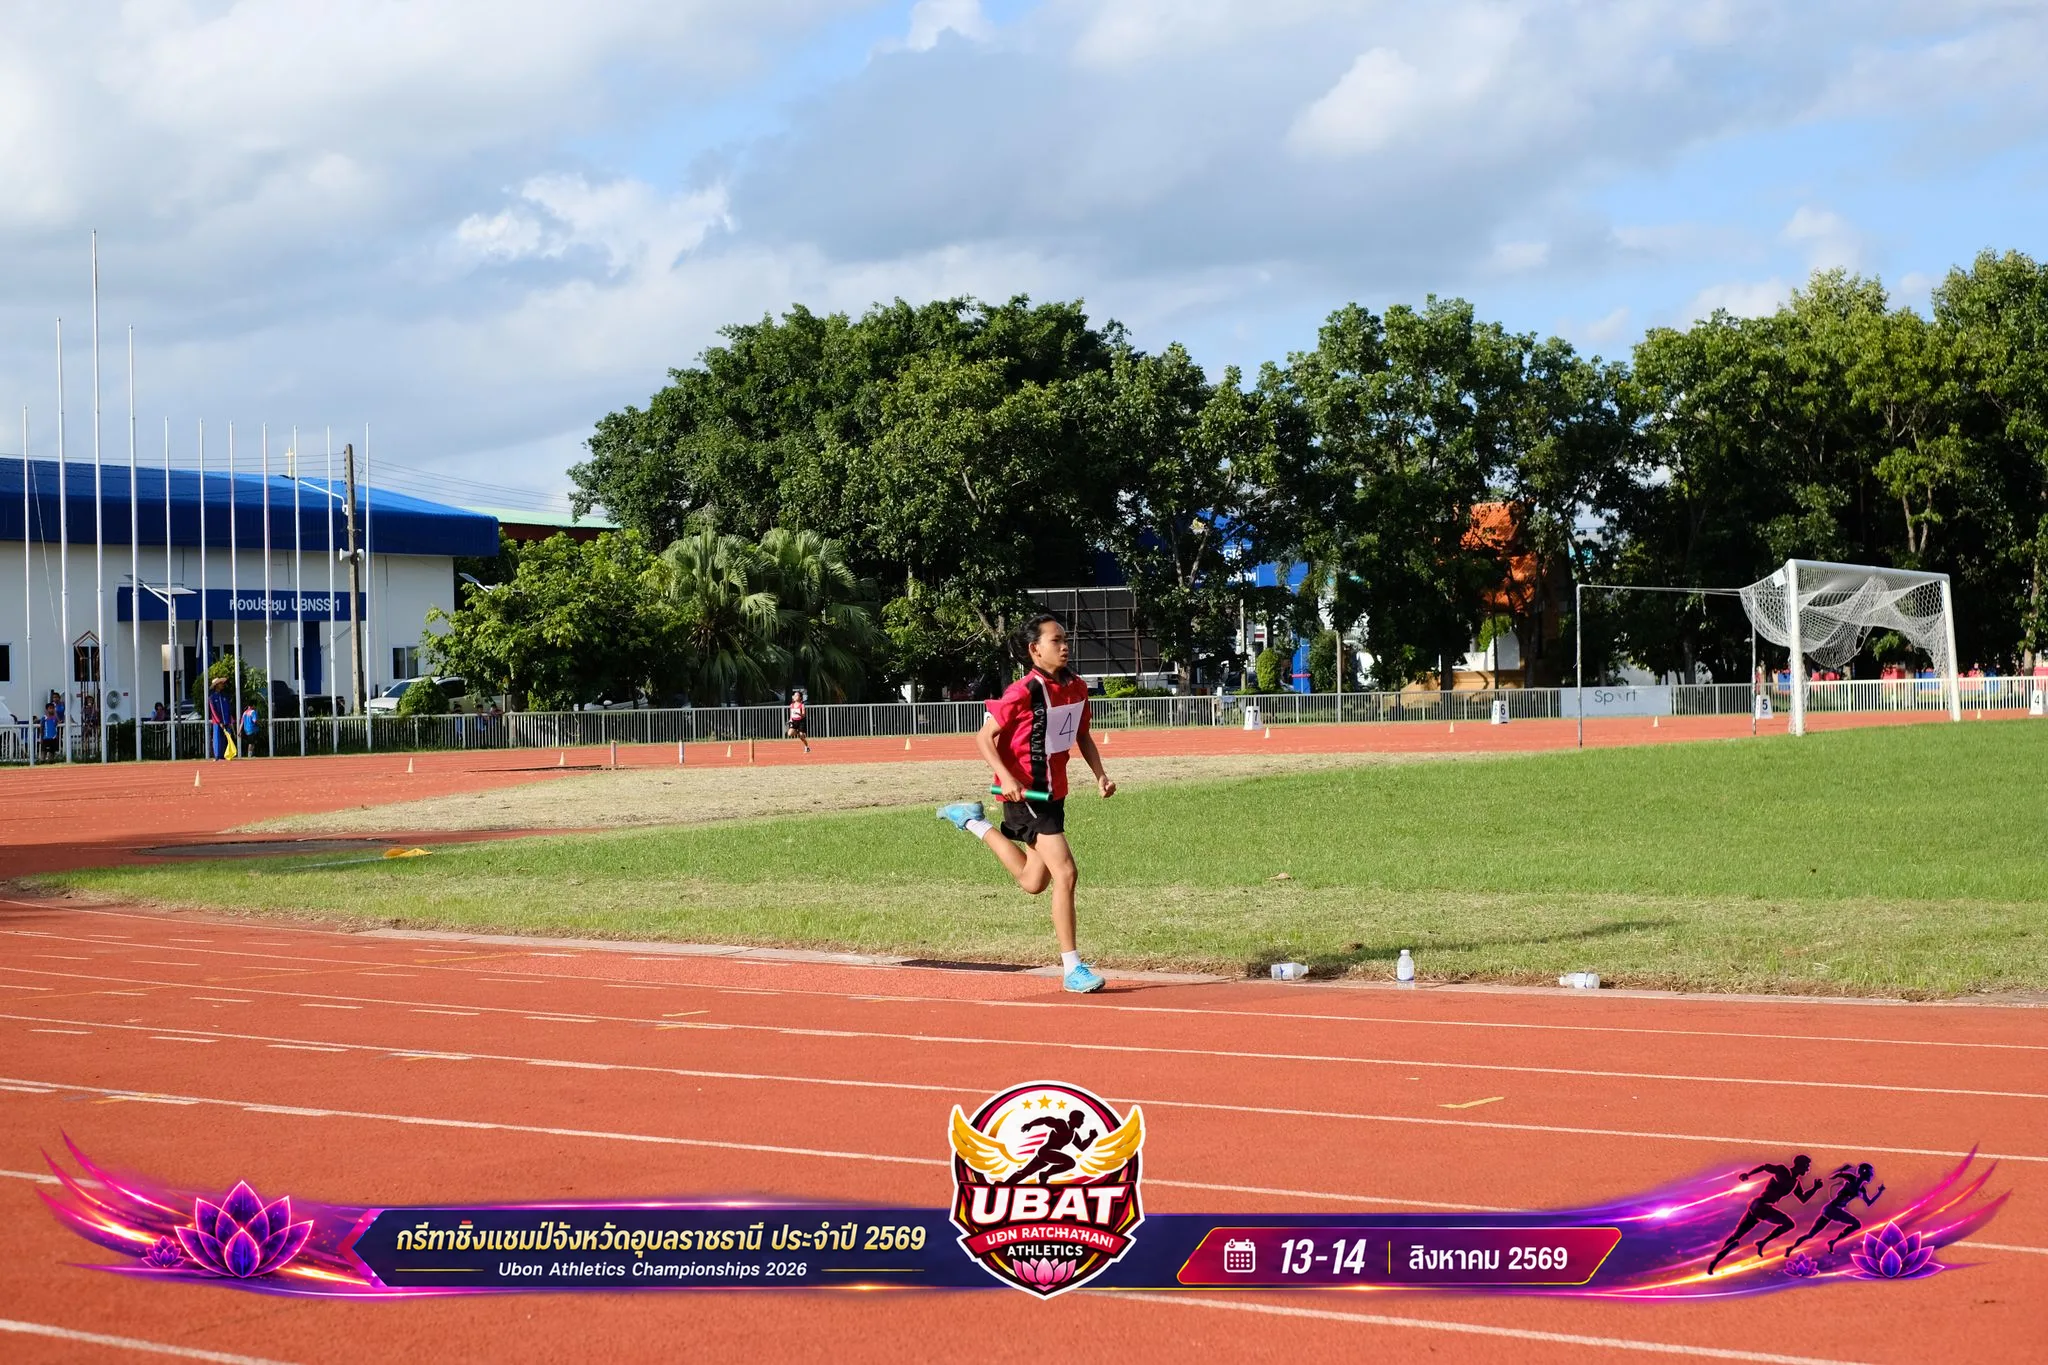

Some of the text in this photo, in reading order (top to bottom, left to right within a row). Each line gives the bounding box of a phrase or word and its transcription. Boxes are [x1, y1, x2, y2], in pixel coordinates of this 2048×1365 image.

[1594, 689, 1637, 705] Sprt
[1500, 703, 1506, 716] 6
[1762, 698, 1768, 711] 5
[1253, 709, 1259, 722] 7
[1059, 712, 1075, 743] 4
